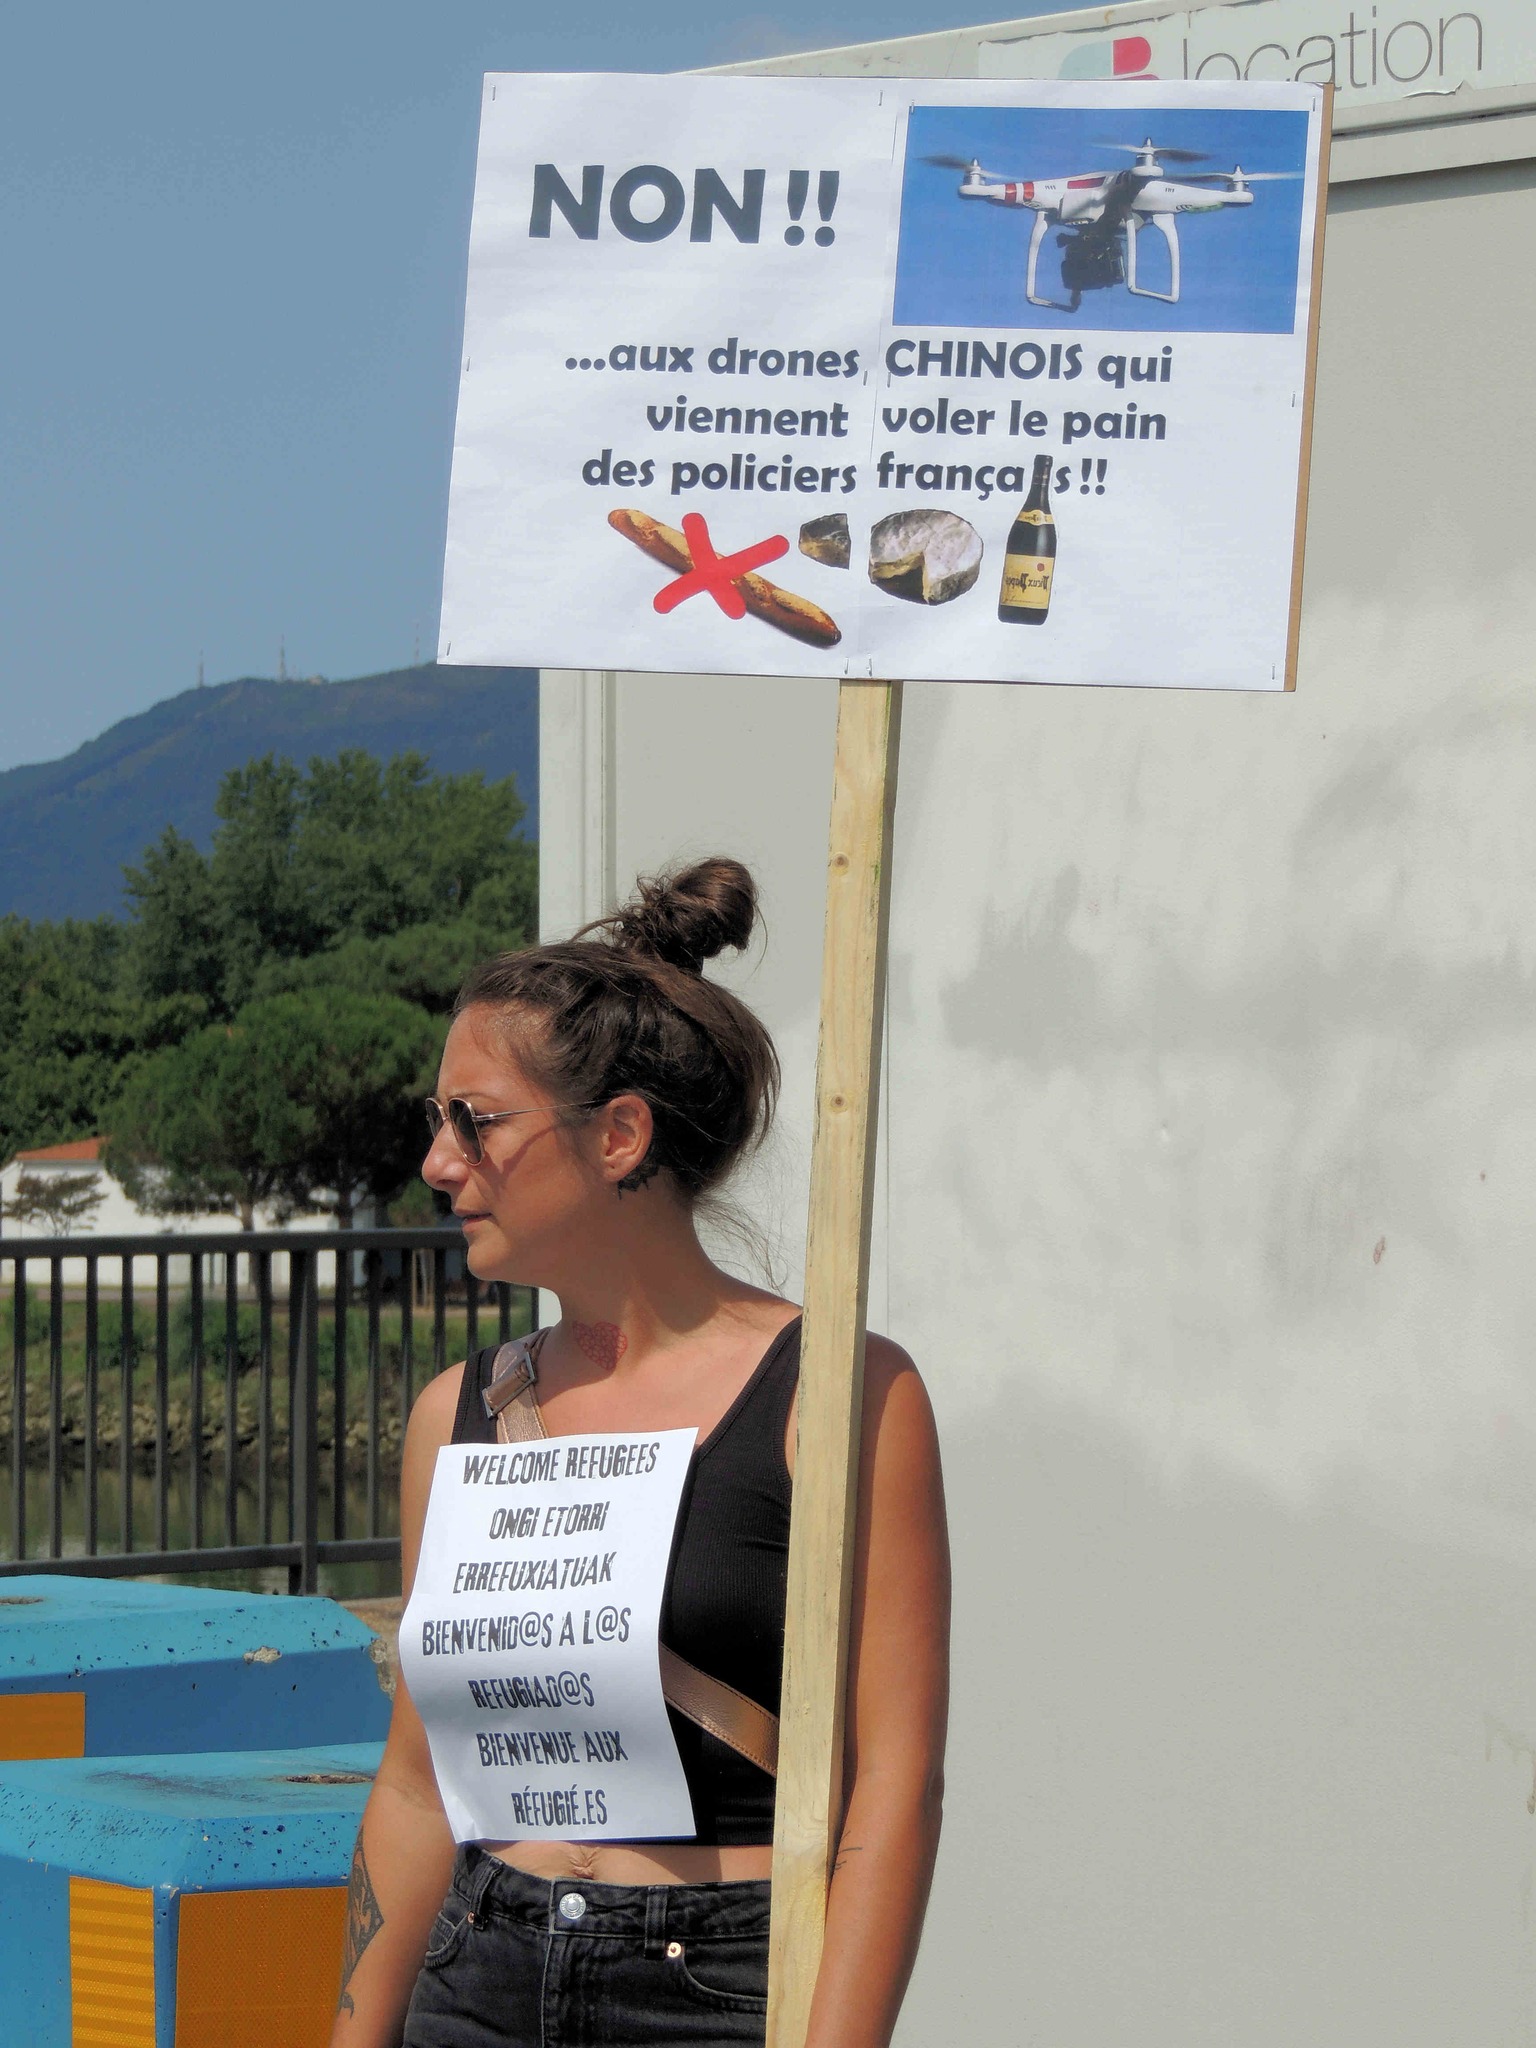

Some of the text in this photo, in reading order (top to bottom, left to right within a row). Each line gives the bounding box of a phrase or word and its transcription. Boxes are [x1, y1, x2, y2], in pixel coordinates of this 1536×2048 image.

[528, 163, 840, 248] NON!!
[565, 337, 1173, 389] ...aux drones CHINOIS qui
[646, 394, 1167, 445] viennent voler le pain
[582, 448, 1108, 502] des policiers franças!!
[463, 1442, 660, 1485] WELCOME REFUGEES
[489, 1501, 610, 1540] ONGI ETORRI
[453, 1552, 617, 1594] ERREFUXIATUAK
[422, 1606, 631, 1656] BIENVENID@S A L@S
[467, 1670, 595, 1710] REFUGIAD@S
[475, 1730, 629, 1767] BIENVENUE AUX
[510, 1784, 608, 1827] RÉFUGIÉ.ES
